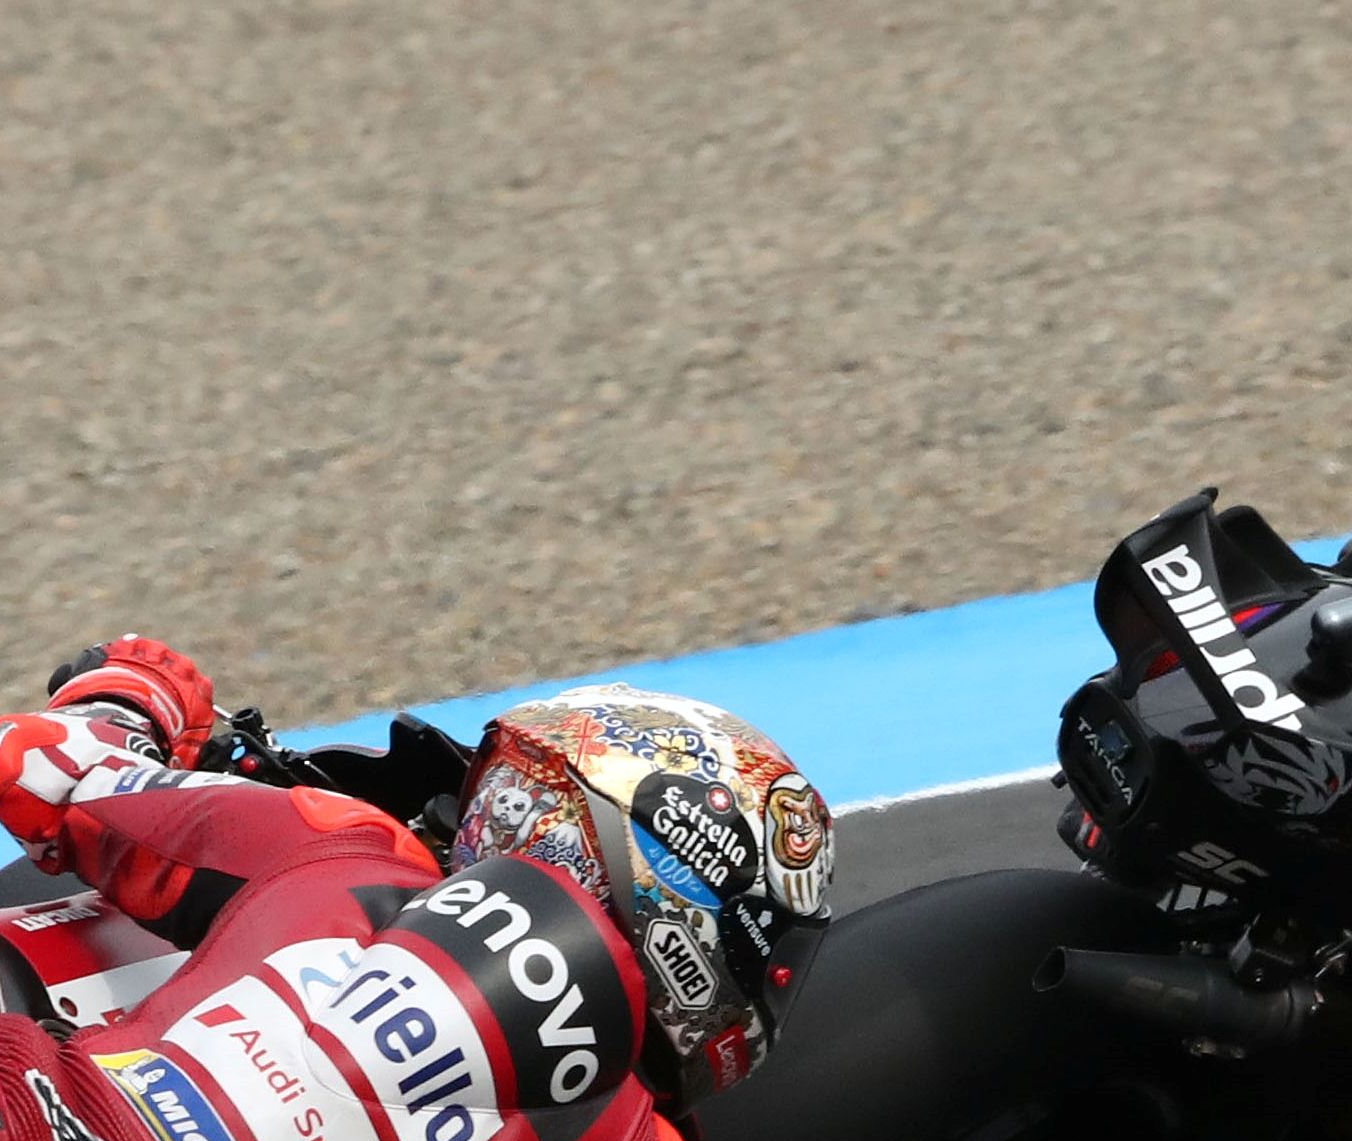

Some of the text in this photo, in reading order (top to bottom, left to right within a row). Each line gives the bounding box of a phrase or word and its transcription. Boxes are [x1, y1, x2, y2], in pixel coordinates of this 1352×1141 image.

[653, 806, 728, 887] Galicia
[661, 786, 747, 867] Estrella
[655, 931, 709, 1000] SHOEI
[737, 902, 771, 957] verisure
[229, 1030, 306, 1104] Audi
